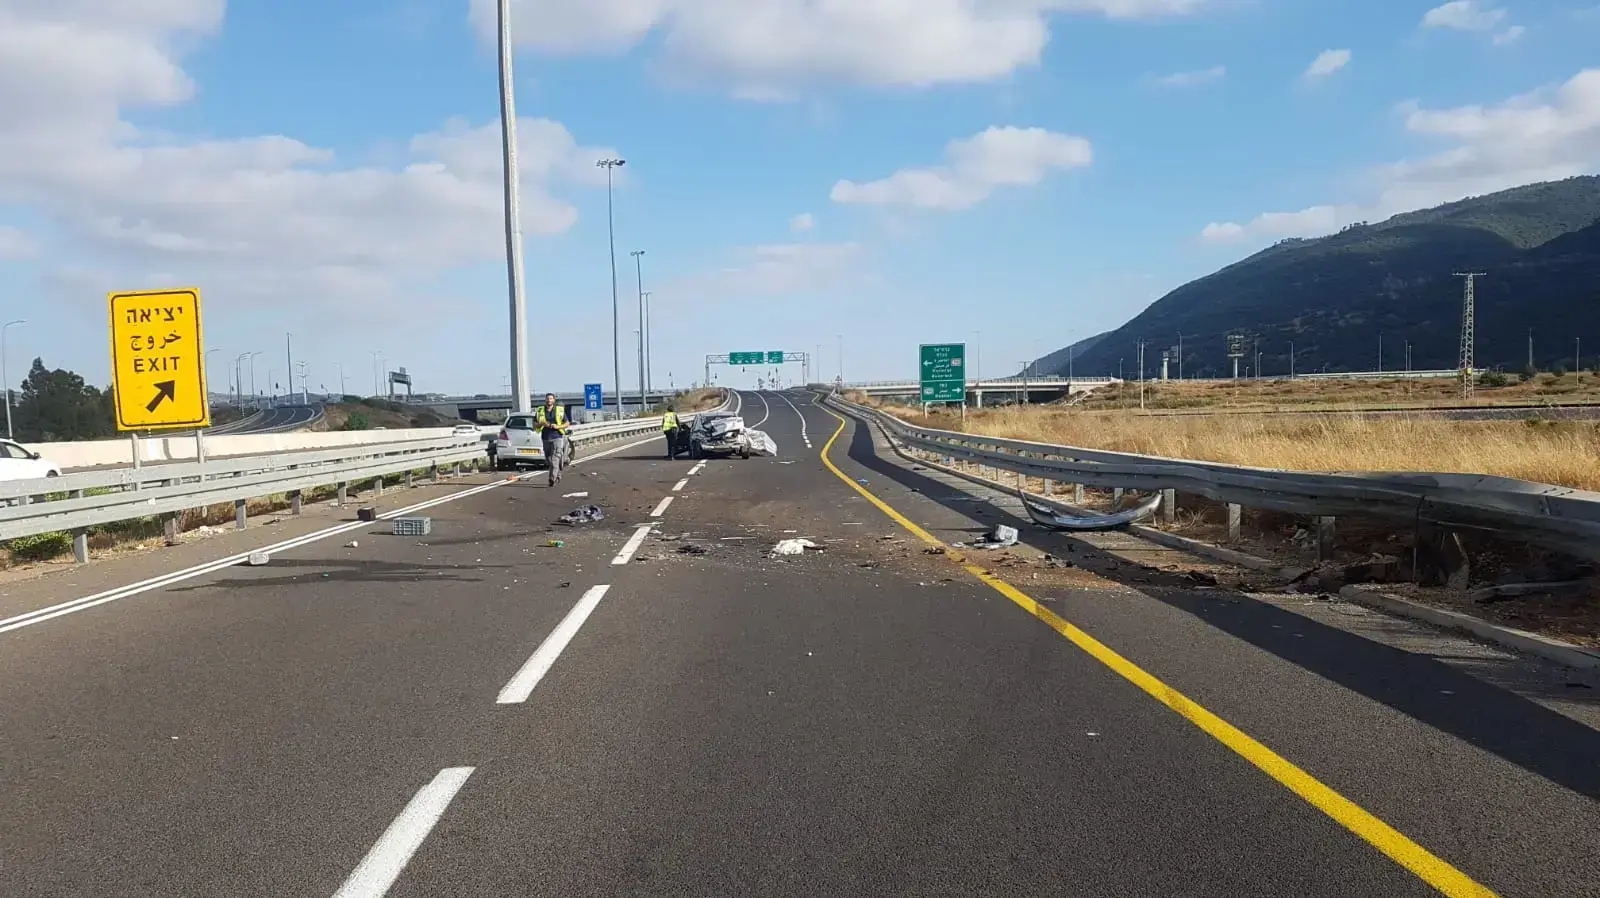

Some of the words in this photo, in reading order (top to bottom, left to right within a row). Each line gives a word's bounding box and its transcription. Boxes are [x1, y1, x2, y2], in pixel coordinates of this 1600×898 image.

[126, 306, 183, 323] יציאה
[130, 329, 182, 351] خروج
[133, 356, 180, 373] EXIT
